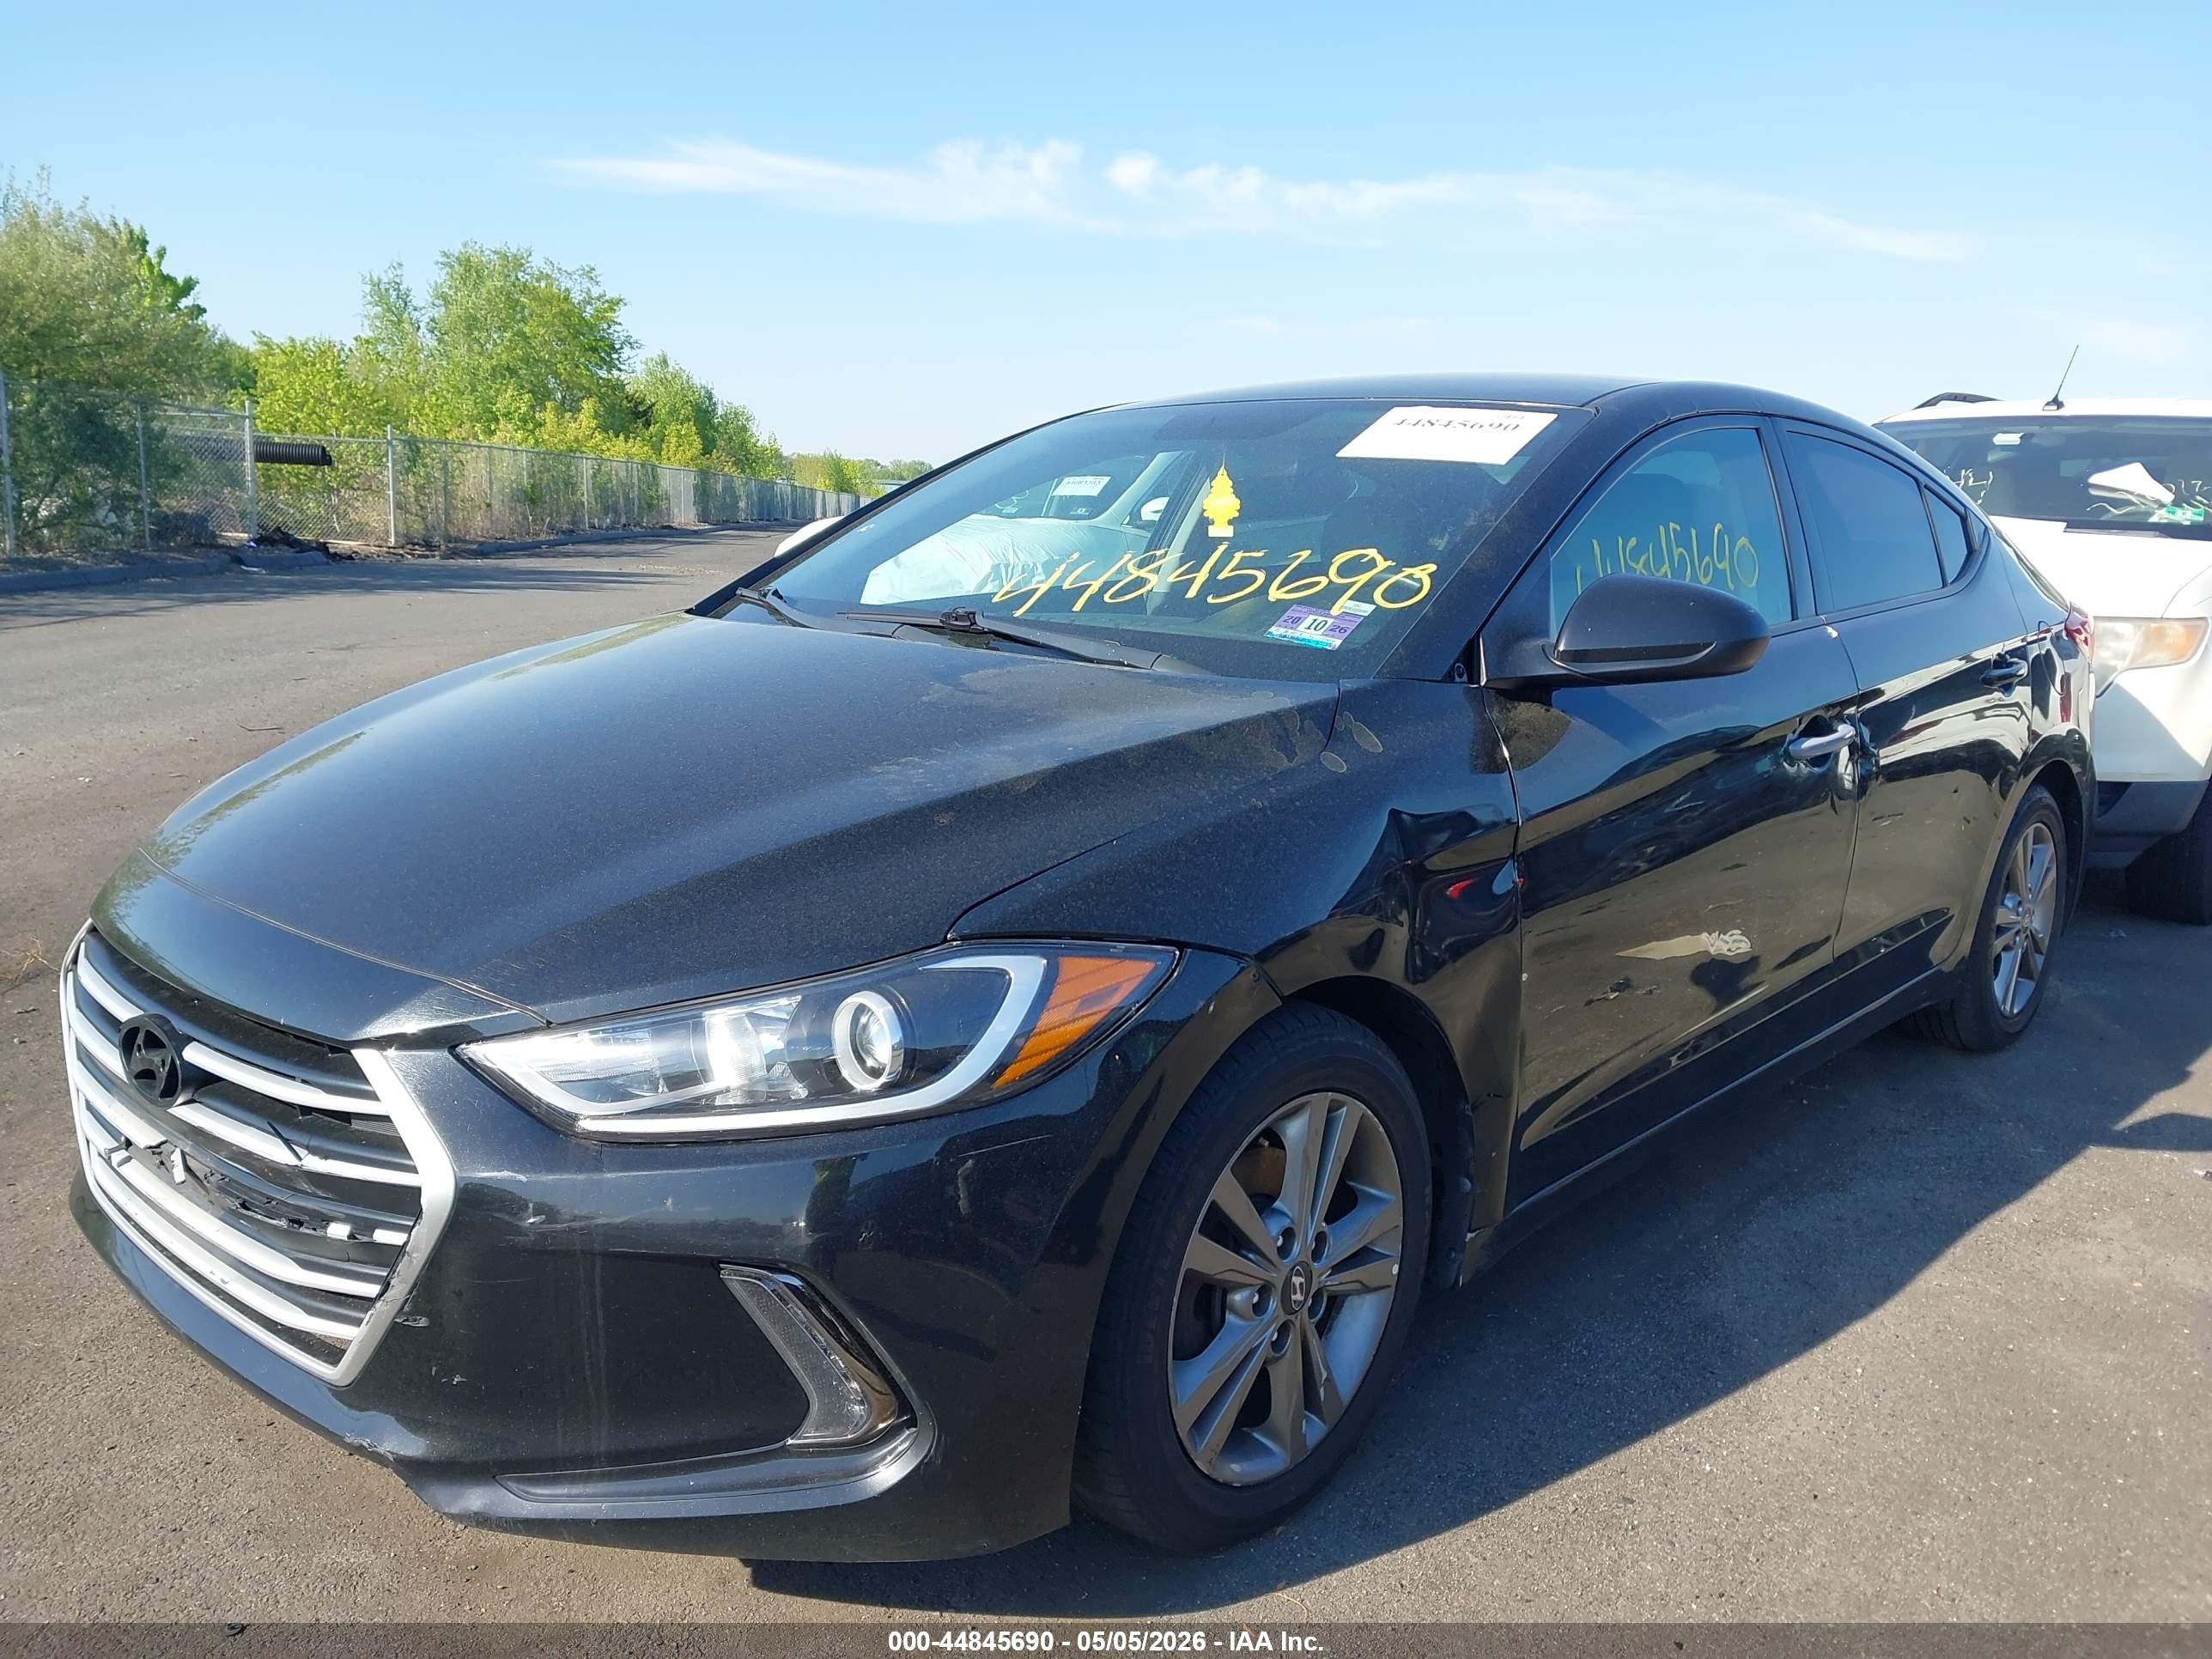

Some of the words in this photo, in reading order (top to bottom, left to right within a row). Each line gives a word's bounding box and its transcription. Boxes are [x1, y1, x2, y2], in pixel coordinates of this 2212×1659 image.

[991, 541, 1437, 617] 44845690
[1283, 616, 1301, 624] 20
[1304, 618, 1328, 632] 10
[1329, 625, 1349, 634] 26
